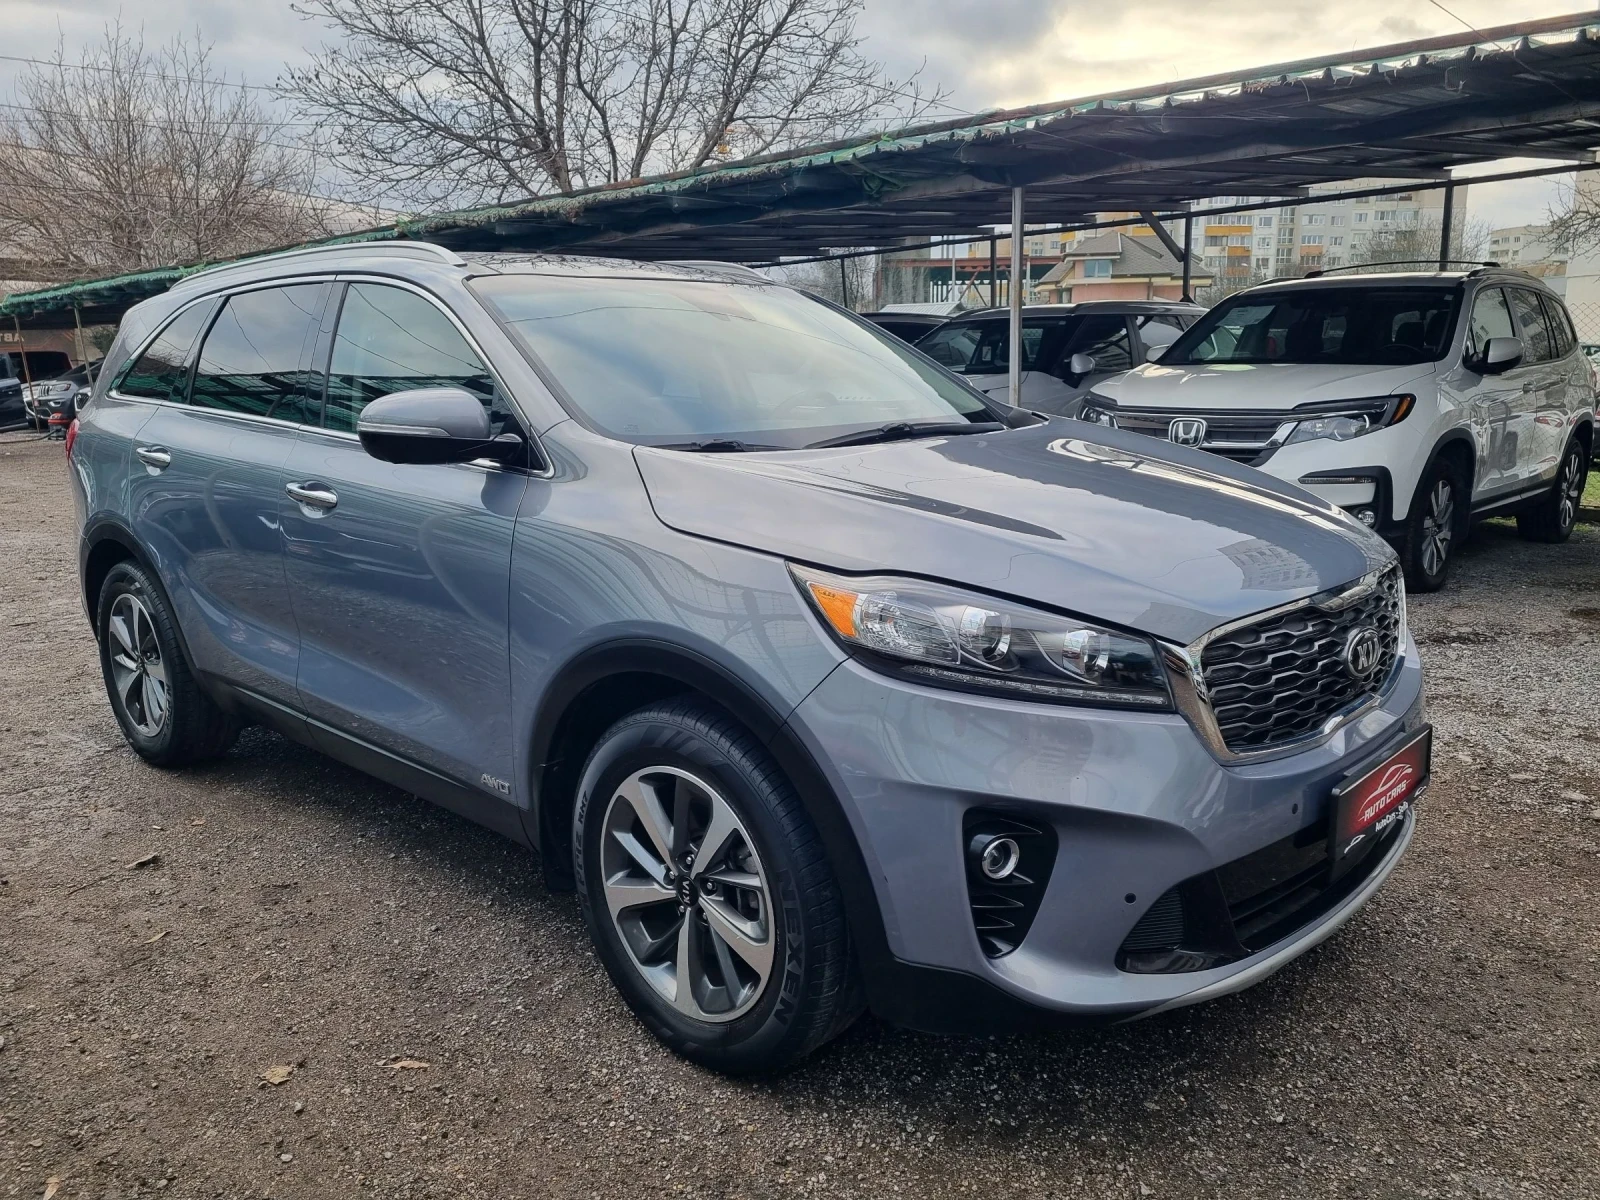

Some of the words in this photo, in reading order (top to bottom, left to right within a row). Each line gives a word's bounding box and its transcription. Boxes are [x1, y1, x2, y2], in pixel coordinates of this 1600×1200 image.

[1357, 637, 1379, 670] KIA
[480, 773, 510, 795] AWD
[1364, 796, 1386, 822] AUTO
[1386, 780, 1407, 804] CARS
[682, 880, 691, 904] KIA
[773, 868, 803, 1028] NEXEN
